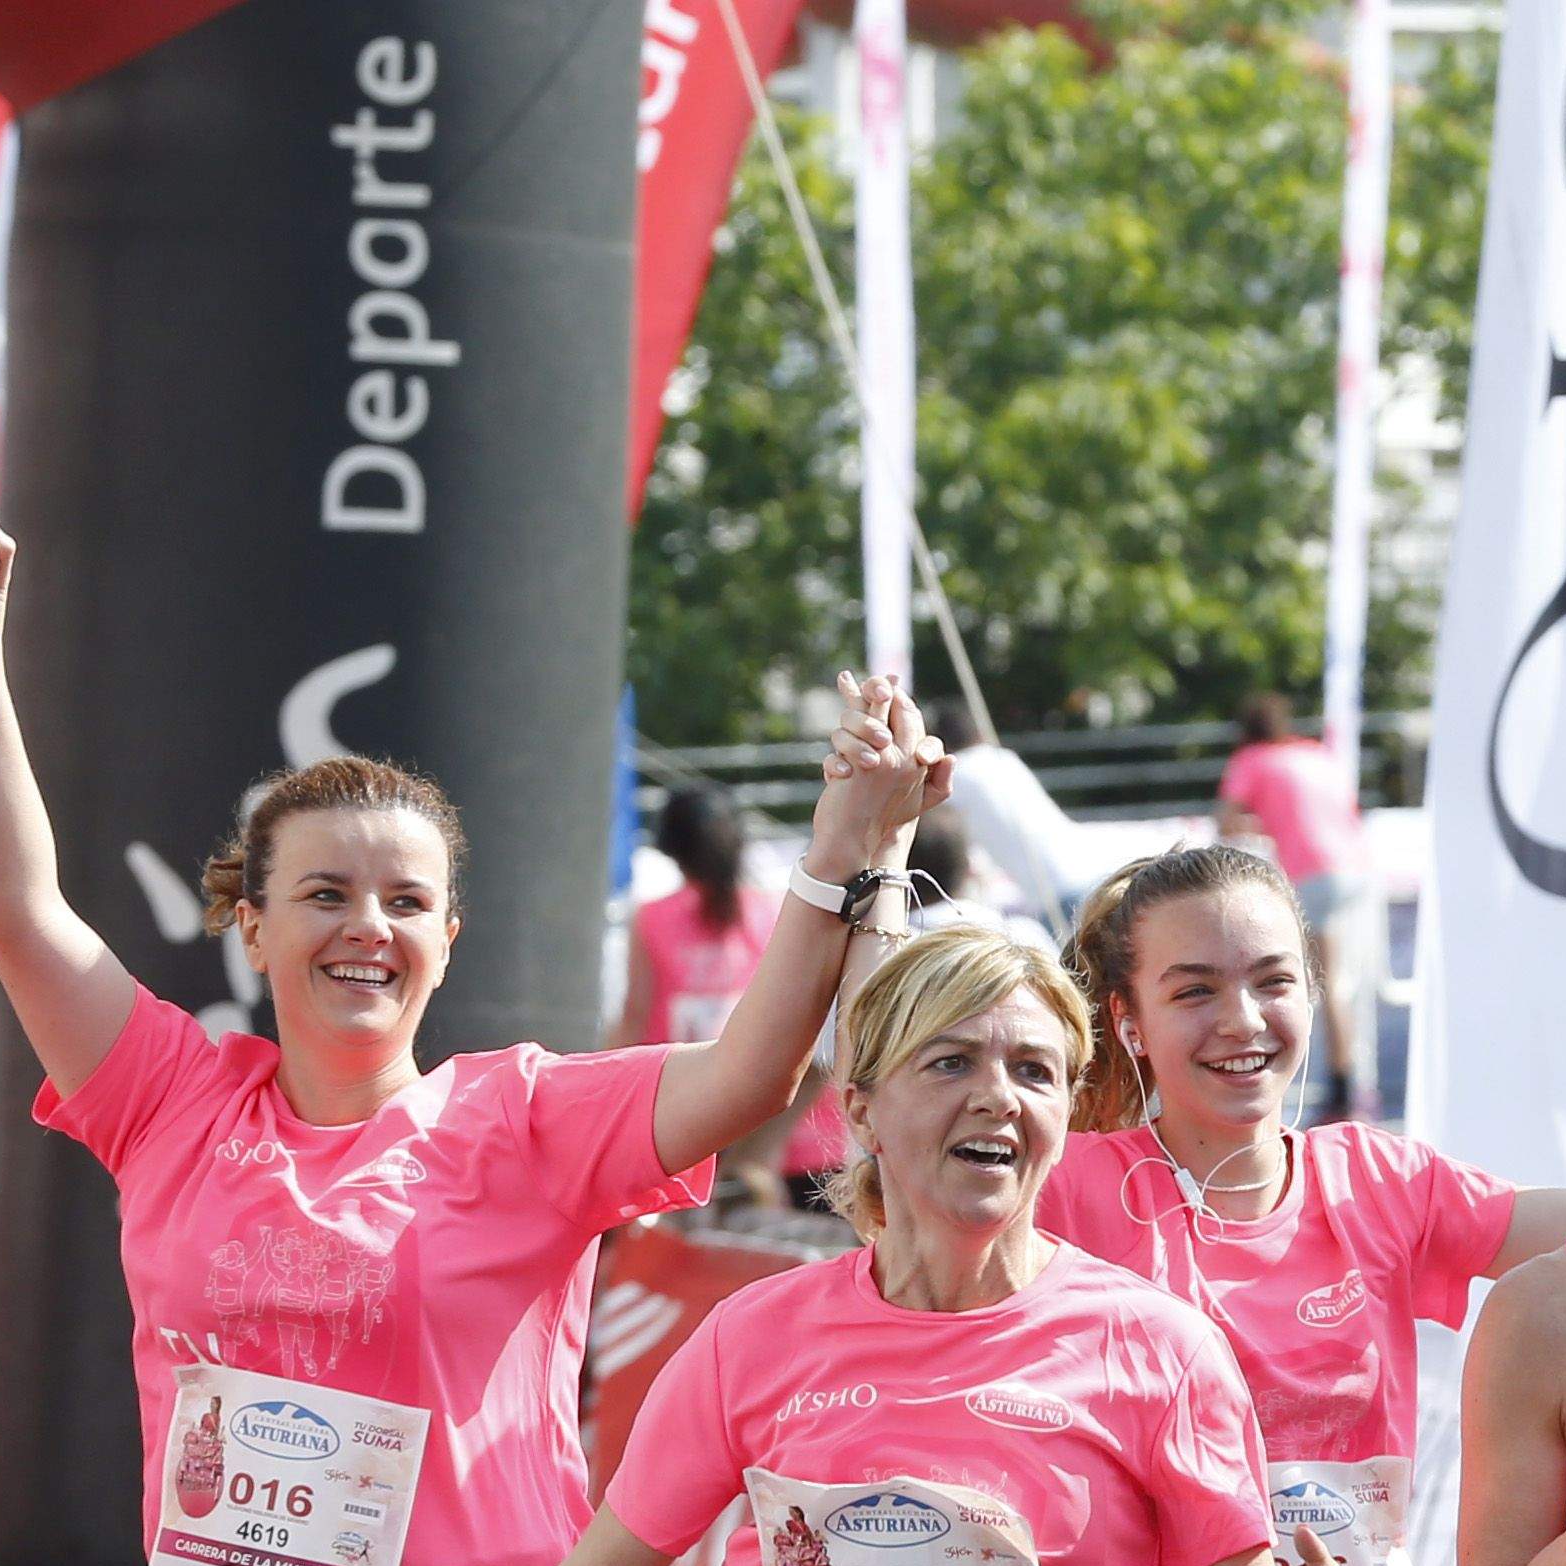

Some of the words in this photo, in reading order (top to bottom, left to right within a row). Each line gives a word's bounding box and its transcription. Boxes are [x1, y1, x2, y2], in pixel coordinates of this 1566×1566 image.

[321, 34, 461, 532] Deporte
[974, 1391, 1064, 1426] ASTURIANA
[235, 1413, 329, 1452] ASTURIANA
[352, 1430, 402, 1452] SUMA
[229, 1472, 314, 1517] 016
[1355, 1489, 1389, 1504] SUMA
[836, 1513, 942, 1533] ASTURIANA
[959, 1511, 1010, 1528] SUMA
[236, 1520, 289, 1547] 4619
[175, 1538, 227, 1561] CARRERA
[231, 1551, 251, 1566] DE
